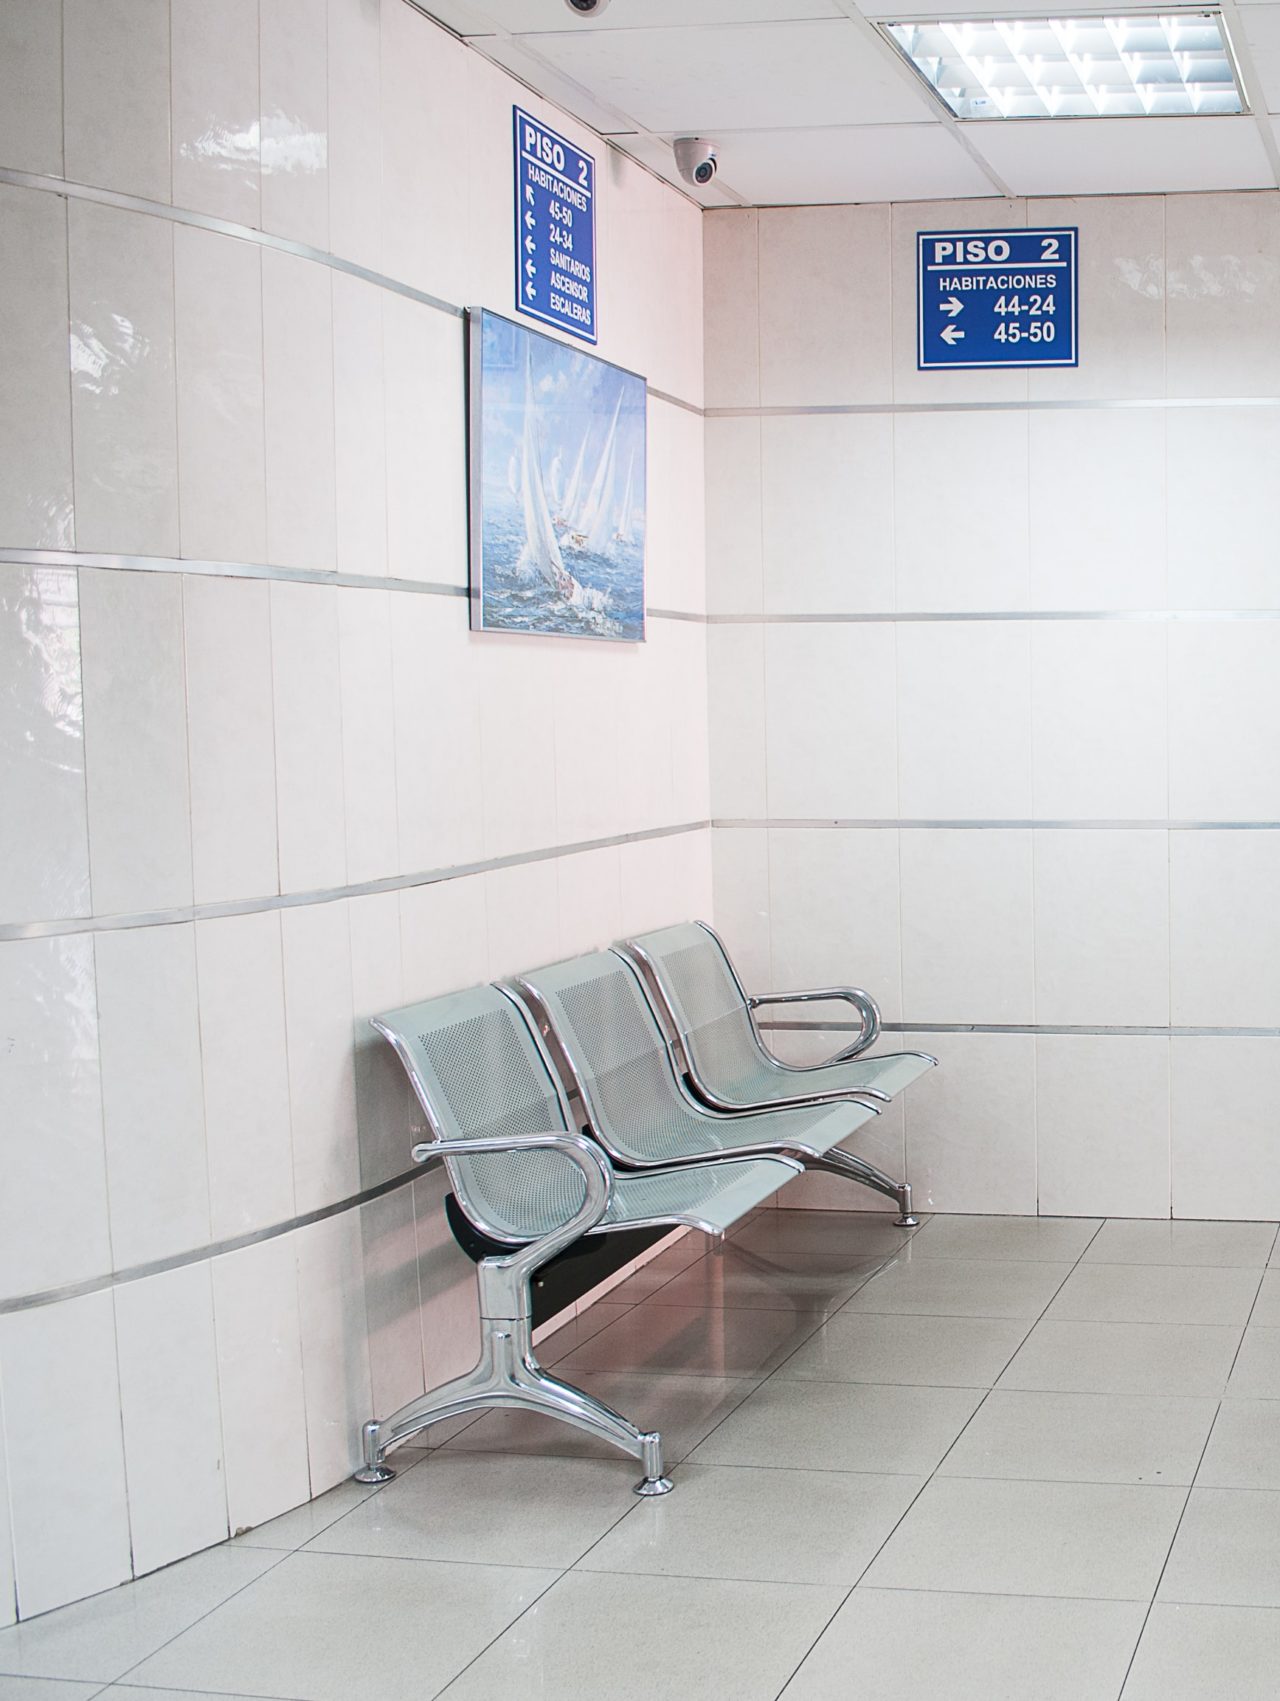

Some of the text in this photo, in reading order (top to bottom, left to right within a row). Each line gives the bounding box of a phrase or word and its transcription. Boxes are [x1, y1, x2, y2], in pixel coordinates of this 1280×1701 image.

[525, 124, 588, 187] PISO 2
[528, 163, 587, 212] HABITACIONES
[549, 200, 572, 228] 45-50
[549, 224, 573, 252] 24-34
[934, 238, 1060, 263] PISO 2
[550, 248, 591, 283] SANITARIOS
[550, 271, 589, 303] ASCENSOR
[939, 274, 1057, 291] HABITACIONES
[550, 292, 591, 326] ESCALERAS
[993, 294, 1056, 316] 44-24
[993, 321, 1055, 343] 45-50
